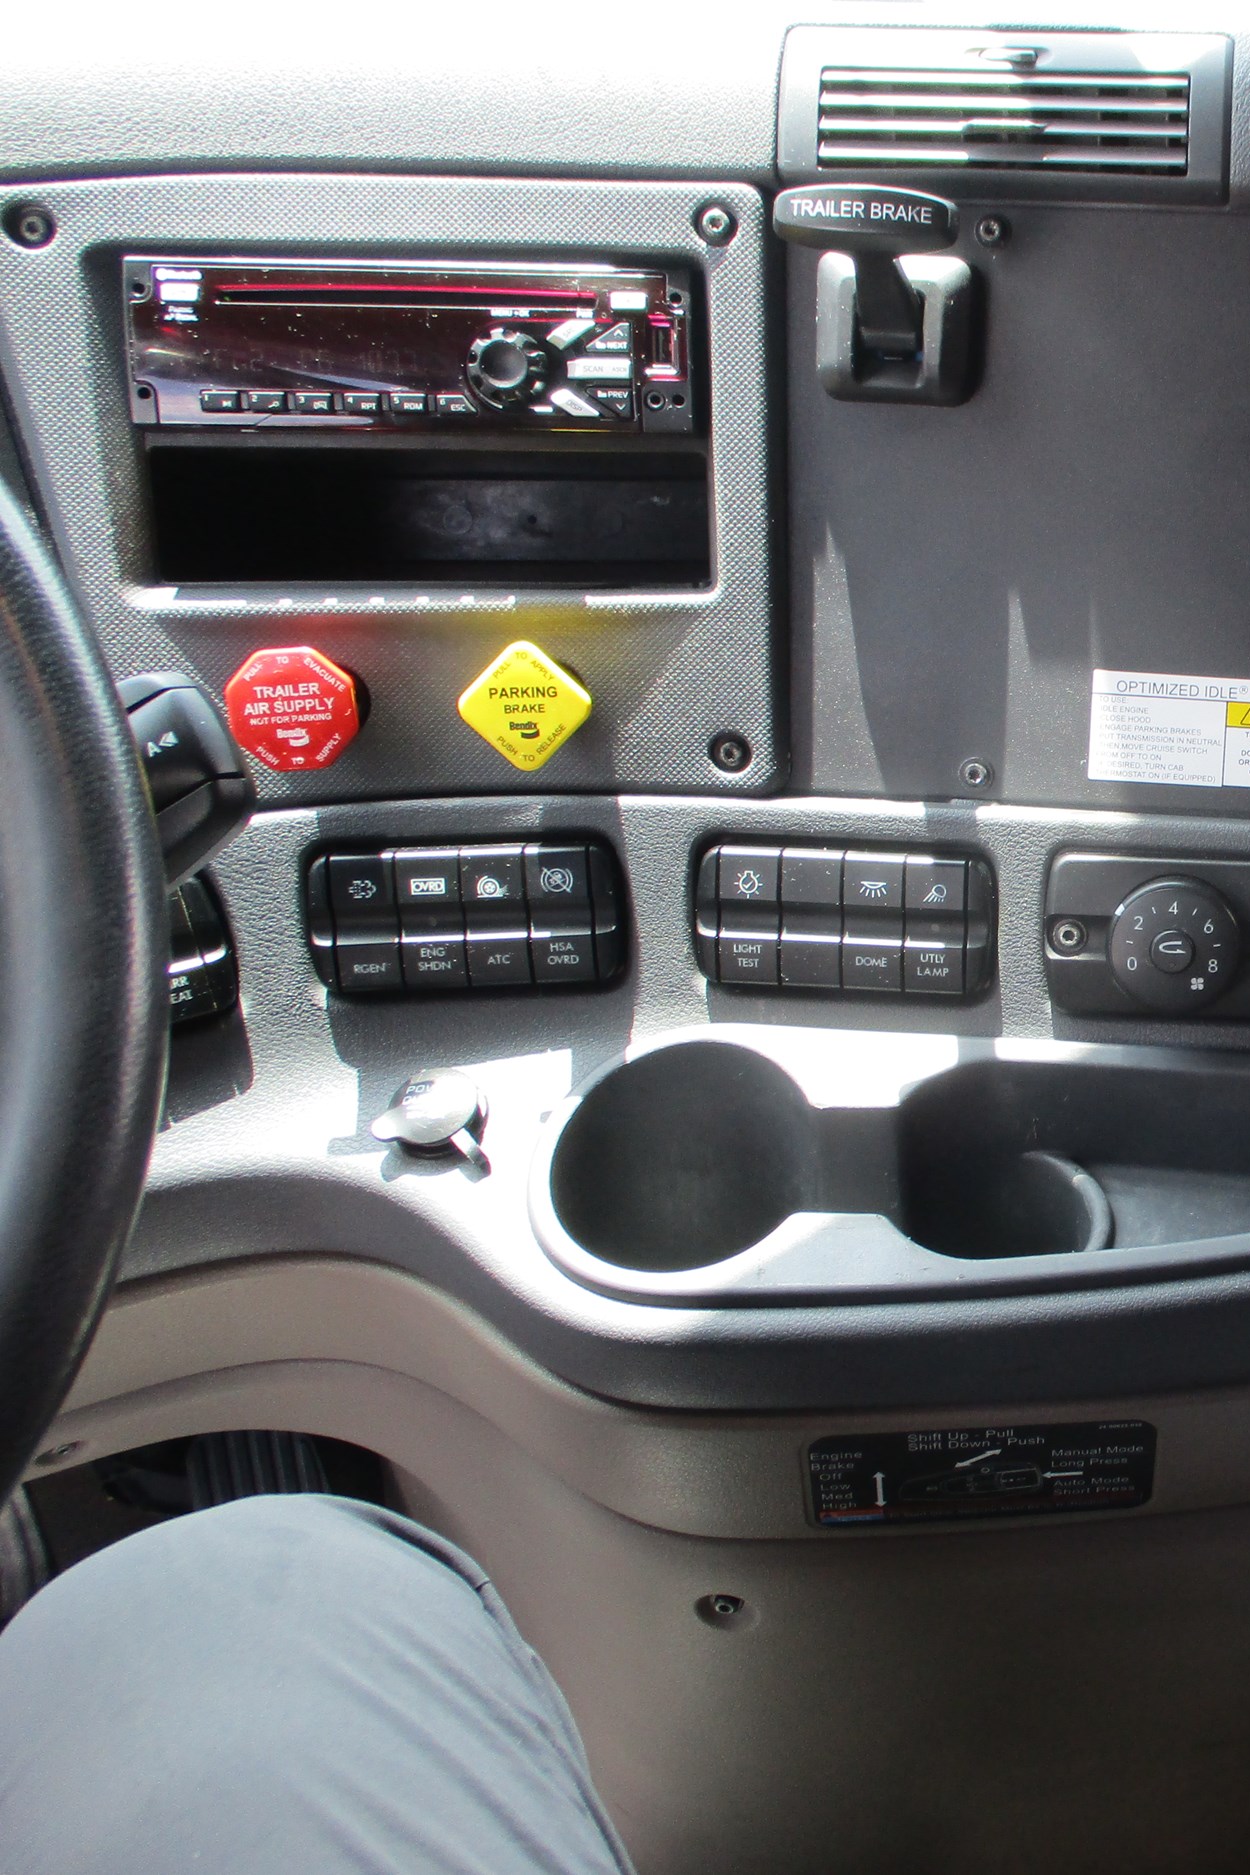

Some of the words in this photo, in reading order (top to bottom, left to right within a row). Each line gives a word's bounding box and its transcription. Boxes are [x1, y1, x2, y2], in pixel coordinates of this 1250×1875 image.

[790, 199, 865, 219] TRAILER
[870, 202, 932, 224] BRAKE
[607, 341, 628, 349] NEXT
[583, 365, 604, 373] SCAN
[450, 403, 466, 412] ESC
[567, 399, 583, 412] DISP
[492, 661, 512, 679] PULL
[515, 652, 528, 660] TO
[530, 660, 555, 681] APPLY
[242, 662, 263, 681] PULL
[276, 656, 289, 665] TO
[303, 657, 346, 693] EVACUATE
[253, 682, 320, 699] TRAILER
[489, 686, 558, 699] PARKING
[1116, 680, 1200, 697] OPTIMIZED
[244, 702, 270, 715] AIR
[273, 697, 335, 713] SUPPLY
[504, 703, 546, 714] BRAKE
[1119, 705, 1149, 715] ENGINE
[250, 716, 269, 726] NOT
[271, 714, 290, 724] FOR
[291, 712, 332, 722] PARKING
[1128, 716, 1152, 724] HOOD
[509, 720, 538, 731] Bendix
[1134, 725, 1168, 735] PARKING
[1170, 728, 1202, 737] BRAKES
[496, 735, 518, 756] PUSH
[522, 754, 535, 762] TO
[536, 723, 567, 755] RELEASE
[1116, 734, 1175, 744] TRANSMISSION
[1177, 736, 1184, 744] IN
[1186, 737, 1222, 747] NEUTRAL
[256, 746, 280, 766] PUSH
[291, 757, 305, 765] TO
[316, 733, 341, 762] SUPPLY
[1145, 744, 1176, 753] CRUISE
[1177, 746, 1208, 756] SWITCH
[1119, 752, 1135, 760] OFF
[1150, 753, 1162, 761] ON
[1238, 758, 1250, 766] OR
[1145, 763, 1166, 771] TURN
[1167, 763, 1184, 772] CAB
[1148, 771, 1160, 779] ON
[1161, 772, 1172, 781] (IF
[1173, 773, 1216, 784] EQUIPPED)
[412, 880, 444, 893] OVRD
[1168, 901, 1179, 915] 4
[1133, 915, 1144, 930] 2
[1203, 918, 1214, 933] 6
[420, 947, 445, 958] ENG
[549, 942, 574, 953] HSA
[733, 943, 762, 956] LIGHT
[487, 953, 511, 965] ATC
[547, 954, 580, 965] OVRD
[738, 957, 759, 968] TEST
[855, 956, 888, 967] DOME
[920, 953, 946, 964] UTLY
[1127, 956, 1138, 971] 0
[353, 962, 386, 974] RGEN
[418, 960, 451, 971] SHDN
[917, 966, 949, 977] LAMP
[1207, 958, 1218, 973] 8
[169, 989, 193, 1005] EAT
[907, 1432, 942, 1443] Shift
[947, 1431, 969, 1441] Up
[985, 1428, 1014, 1439] Pull
[907, 1441, 943, 1452] Shift
[948, 1439, 990, 1449] Down
[1007, 1436, 1045, 1446] Push
[810, 1451, 863, 1462] Engine
[1051, 1447, 1101, 1457] Manual
[1106, 1444, 1144, 1454] Mode
[811, 1462, 855, 1471] Brake
[1051, 1458, 1084, 1468] Long
[1089, 1456, 1128, 1466] Press
[819, 1472, 843, 1481] Off
[1053, 1479, 1086, 1487] Auto
[1091, 1475, 1129, 1485] Mode
[820, 1483, 851, 1492] Low
[1053, 1486, 1091, 1495] Short
[1096, 1484, 1136, 1493] Press
[821, 1492, 854, 1501] Med
[822, 1501, 857, 1510] High
